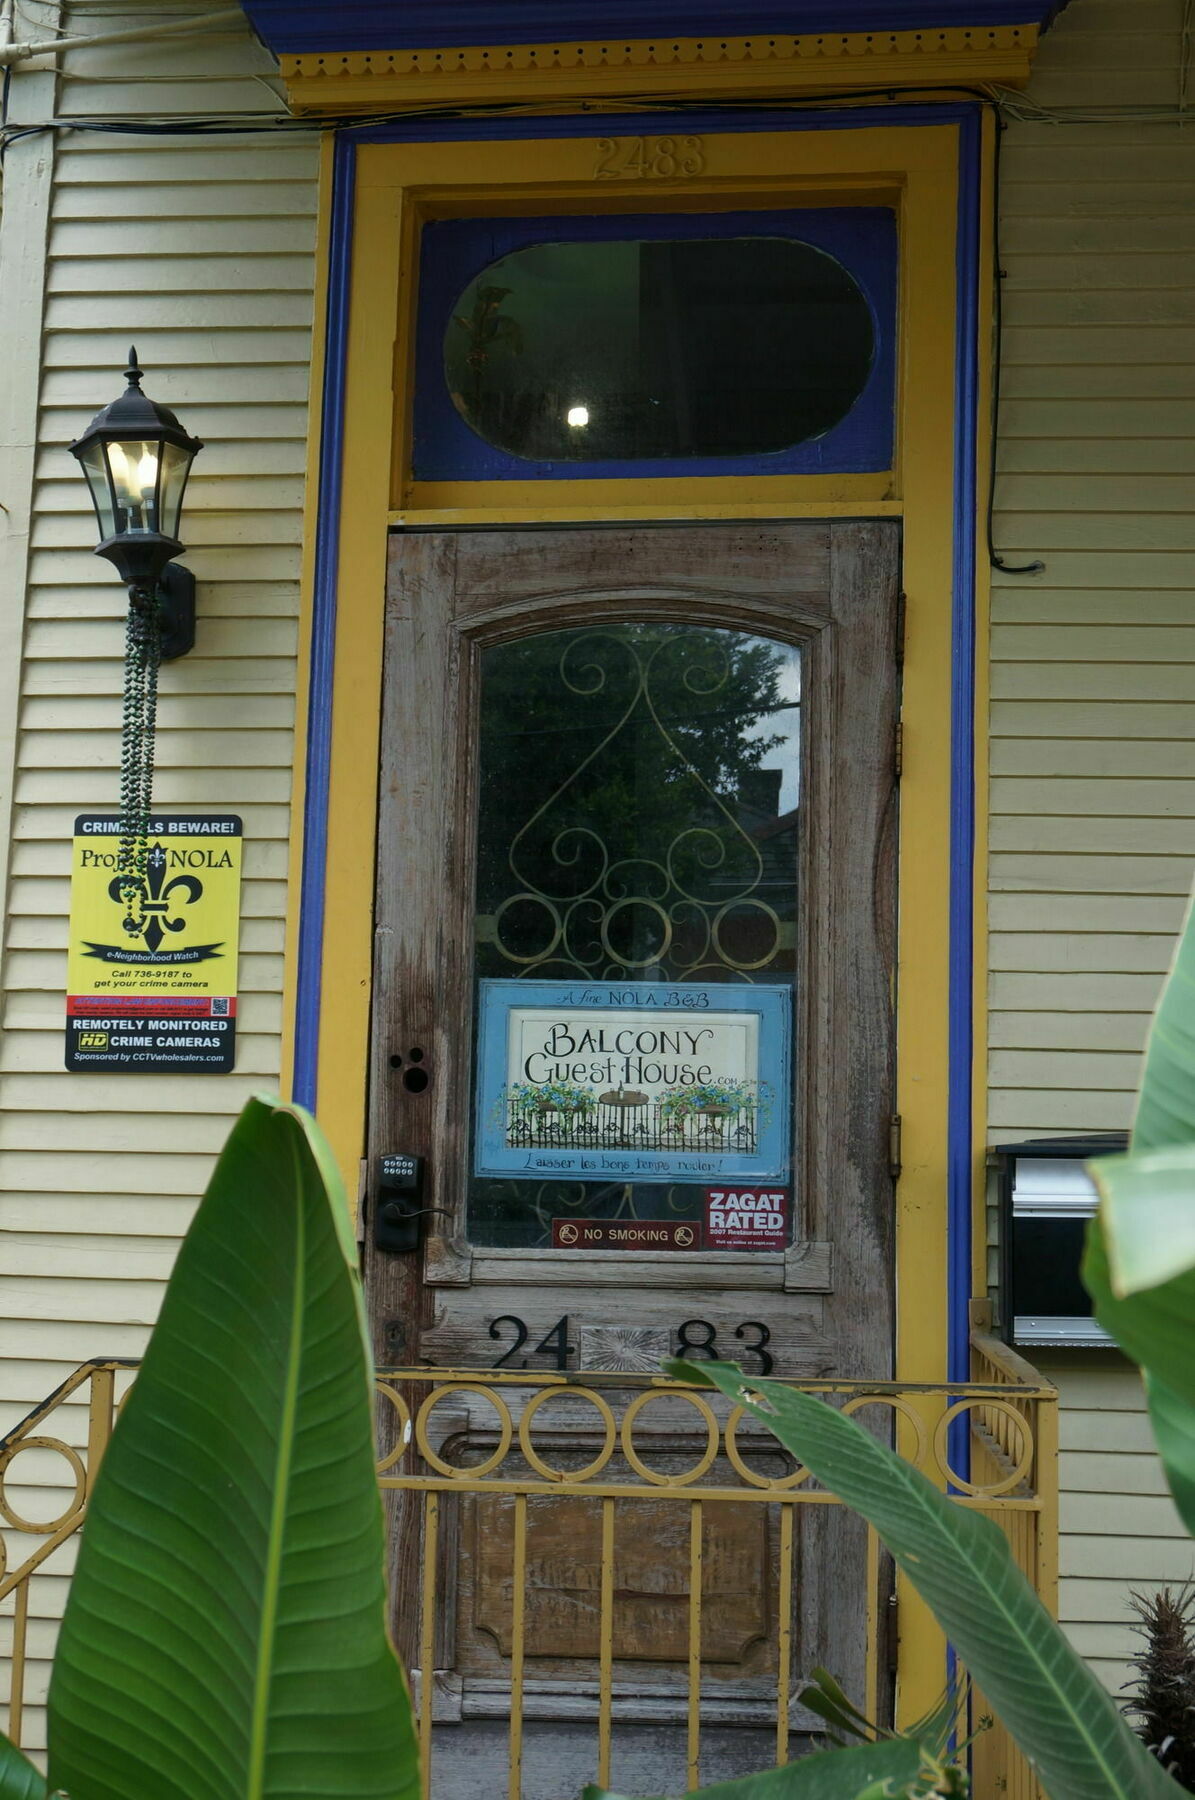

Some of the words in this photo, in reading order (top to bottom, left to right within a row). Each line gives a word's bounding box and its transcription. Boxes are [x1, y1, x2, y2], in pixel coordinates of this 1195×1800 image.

[592, 135, 706, 180] 2483
[83, 822, 164, 834] CRIMLS
[168, 822, 235, 834] BEWARE!
[170, 849, 233, 868] NOLA
[106, 951, 172, 962] e-Neighborhood
[173, 951, 199, 961] Watch
[111, 970, 132, 978] Call
[133, 970, 179, 978] 736-9187
[94, 980, 111, 988] get
[113, 980, 137, 988] your
[609, 991, 658, 1006] NOLA
[663, 991, 709, 1008] B&B
[73, 1019, 145, 1030] REMOTELY
[147, 1020, 228, 1031] MONITORED
[80, 1033, 107, 1046] HD
[110, 1036, 153, 1047] CRIME
[156, 1037, 221, 1048] CAMERAS
[543, 1023, 714, 1058] BALCONY
[74, 1052, 119, 1062] Sponsored
[120, 1053, 131, 1062] by
[132, 1053, 225, 1062] CCTVwholesalers.com
[524, 1052, 616, 1085] Guest
[709, 1192, 785, 1211] ZAGAT
[709, 1211, 784, 1230] RATED
[584, 1229, 603, 1240] NO
[608, 1229, 669, 1241] SMOKING
[488, 1314, 575, 1371] 24
[675, 1319, 774, 1377] 83
